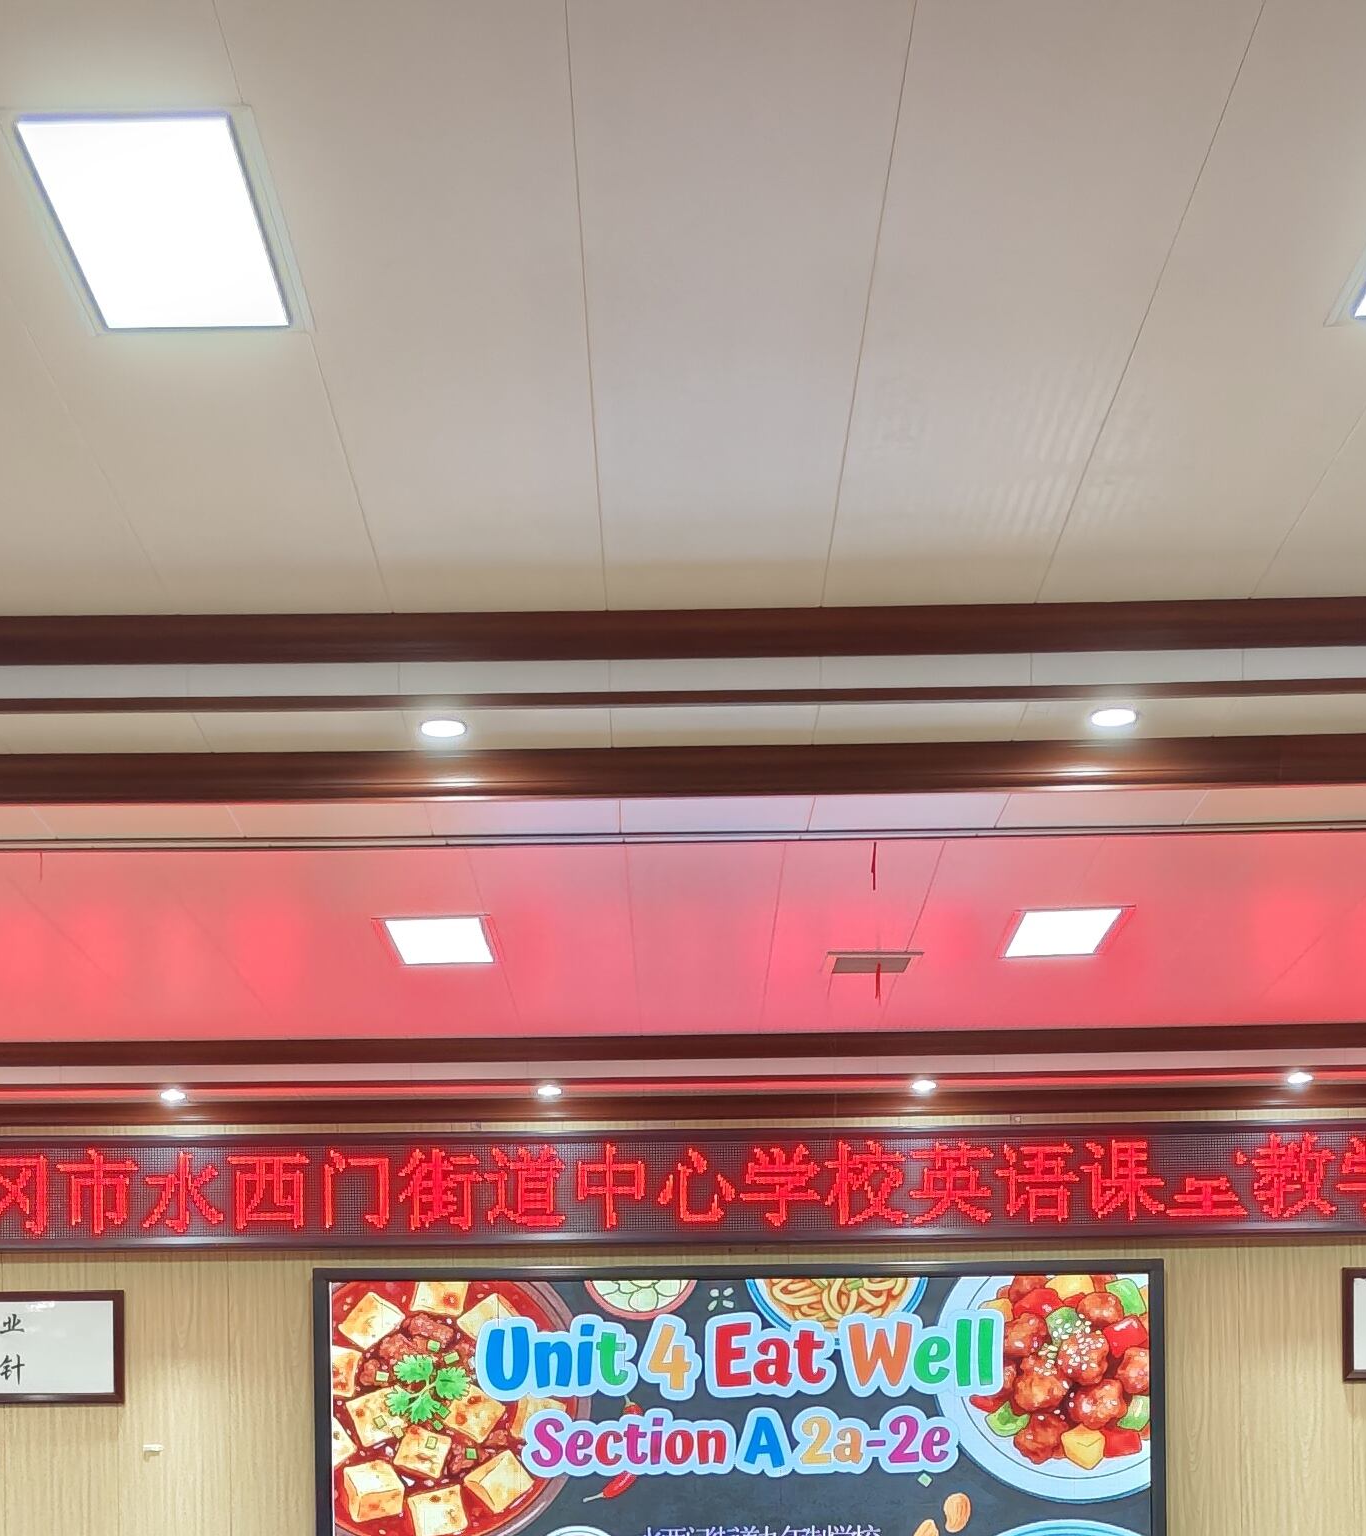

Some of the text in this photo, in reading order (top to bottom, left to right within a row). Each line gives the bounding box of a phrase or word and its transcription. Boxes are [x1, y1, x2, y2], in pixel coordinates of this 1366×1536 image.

[484, 1317, 995, 1392] Unit 4 Eat Well
[533, 1415, 950, 1468] Section A 2a-2e
